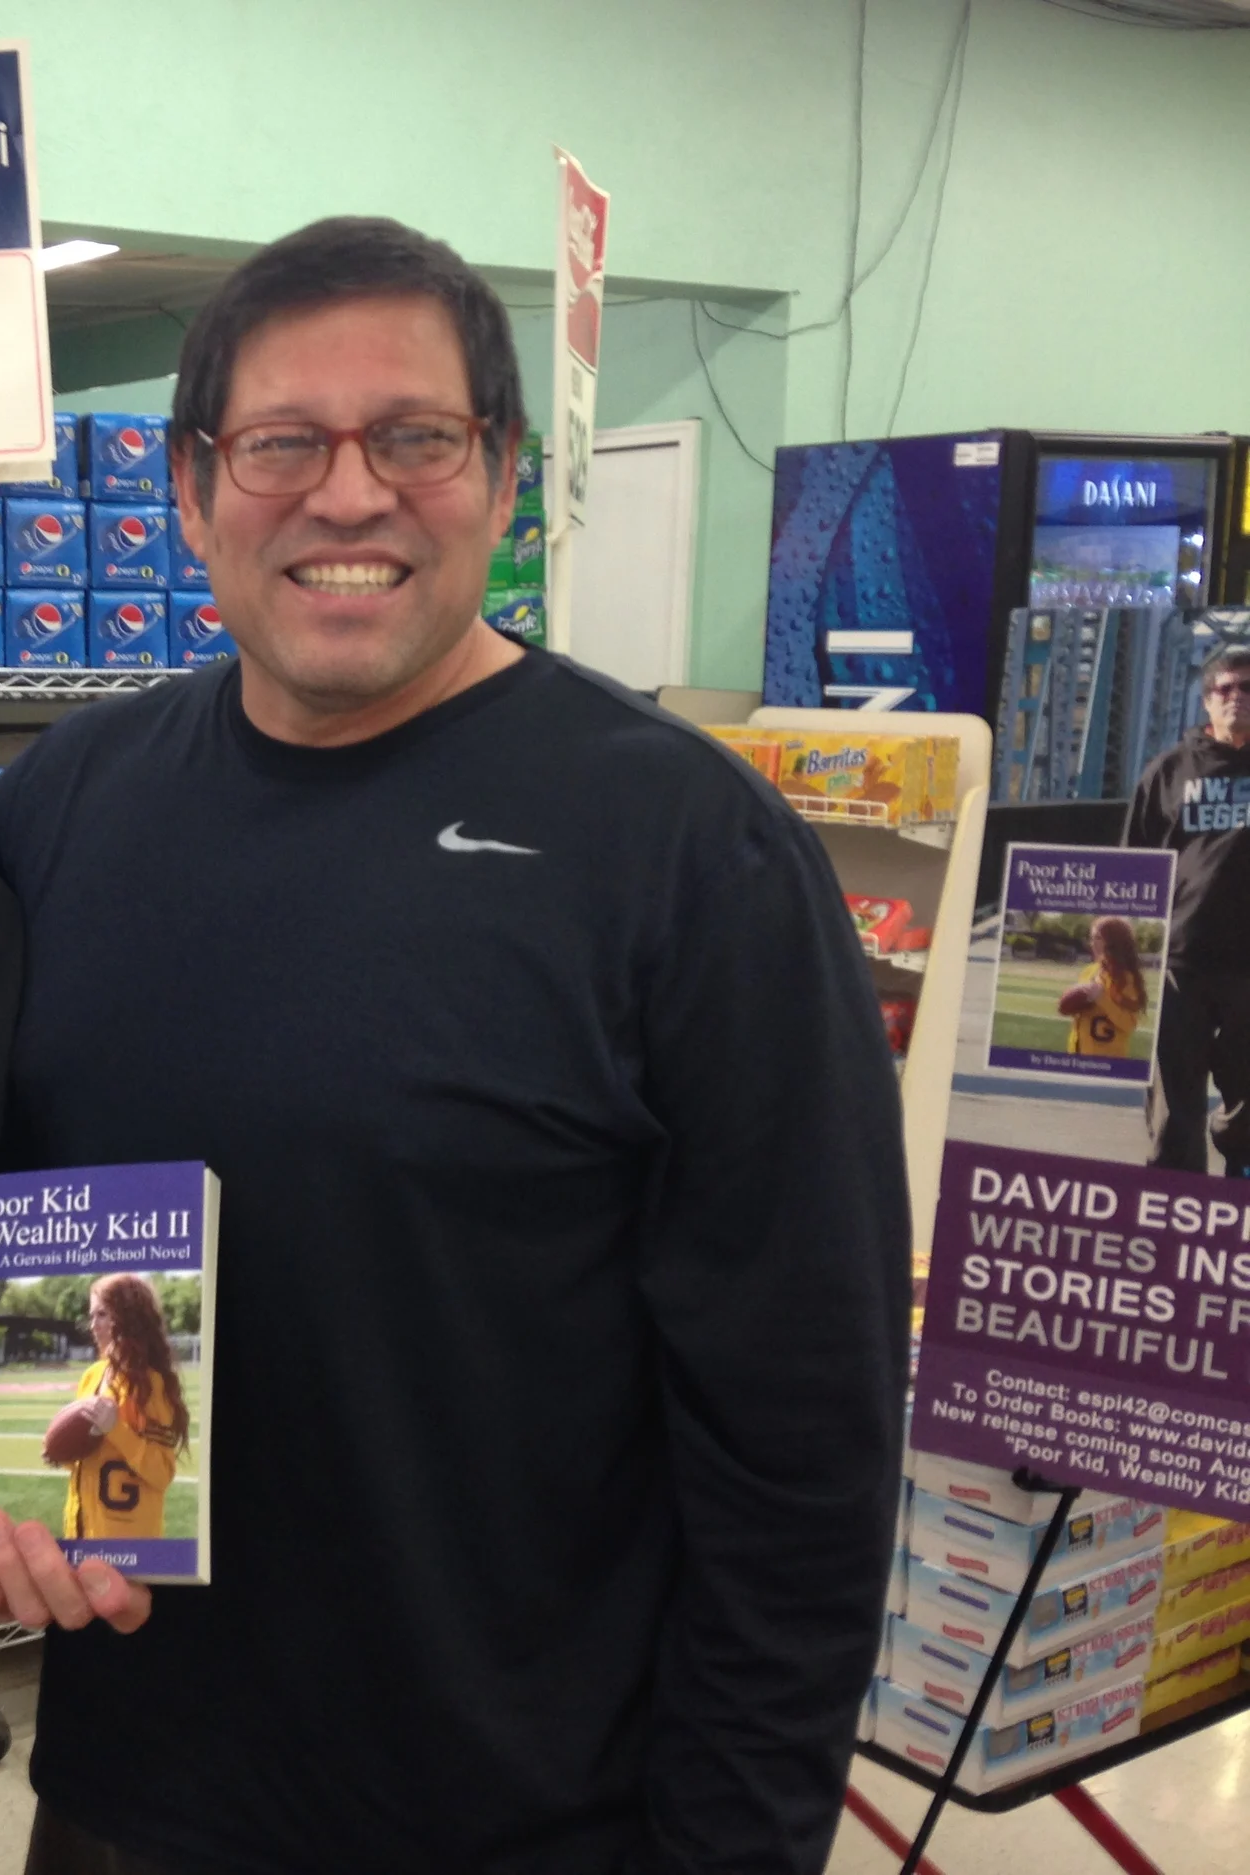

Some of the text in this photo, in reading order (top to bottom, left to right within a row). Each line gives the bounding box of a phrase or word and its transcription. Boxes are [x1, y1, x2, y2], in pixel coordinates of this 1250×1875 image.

[1083, 479, 1158, 508] DASANI
[806, 748, 867, 775] Barritas
[1183, 802, 1250, 832] LEGE
[1017, 860, 1097, 880] Poor Kid
[1028, 878, 1158, 901] Wealthy Kid II
[41, 1184, 91, 1213] Kid
[970, 1167, 1250, 1242] DAVID ESPI
[107, 1211, 158, 1240] Kid
[168, 1210, 191, 1239] II
[0, 1245, 191, 1268] A Gervais High School Novel
[969, 1210, 1250, 1292] WRITES INS
[961, 1254, 1176, 1323] STORIES
[955, 1297, 1229, 1380] BEAUTIFUL
[985, 1368, 1071, 1402] Contact:
[952, 1381, 1250, 1460] To Order Books: www.david
[932, 1398, 1250, 1487] New release coming soon Aug
[97, 1459, 141, 1512] G
[1068, 1448, 1110, 1478] Kid,
[1118, 1459, 1207, 1499] Wealthy
[1213, 1479, 1250, 1505] Kid
